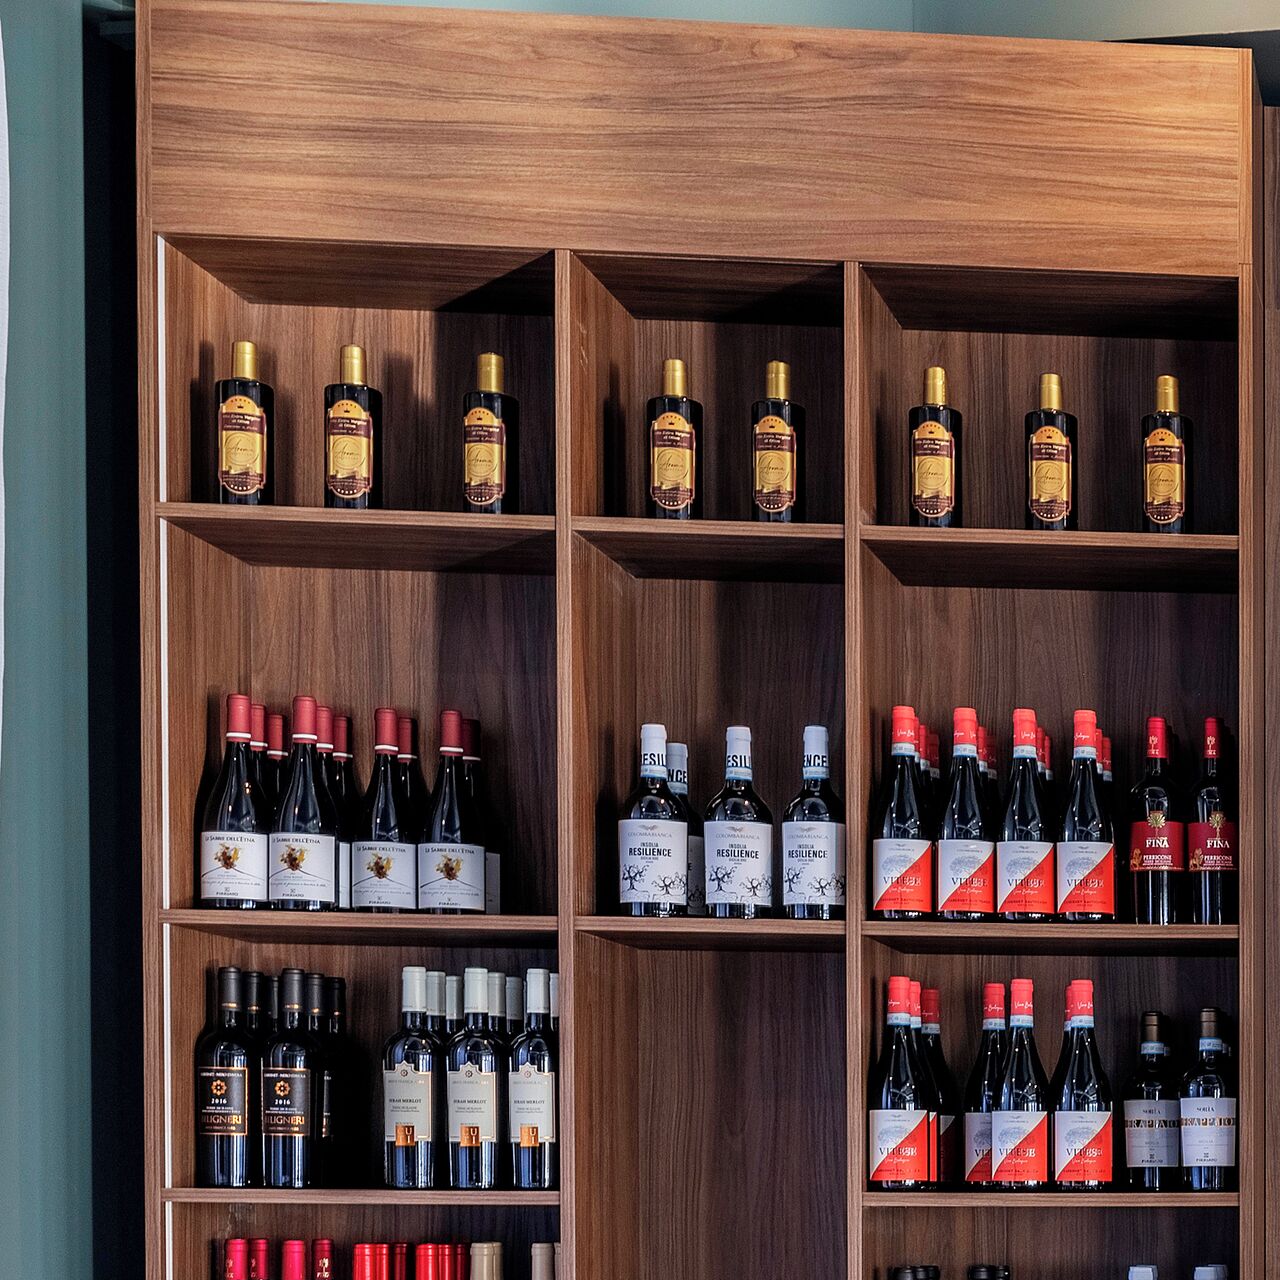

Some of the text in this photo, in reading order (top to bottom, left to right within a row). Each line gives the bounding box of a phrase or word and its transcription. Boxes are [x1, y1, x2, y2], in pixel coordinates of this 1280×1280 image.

[1146, 839, 1169, 848] FINA
[1207, 840, 1230, 848] FINA
[629, 848, 672, 857] RESILIENCE
[717, 849, 759, 859] RESILIENCE
[788, 850, 828, 858] RESILIENCE
